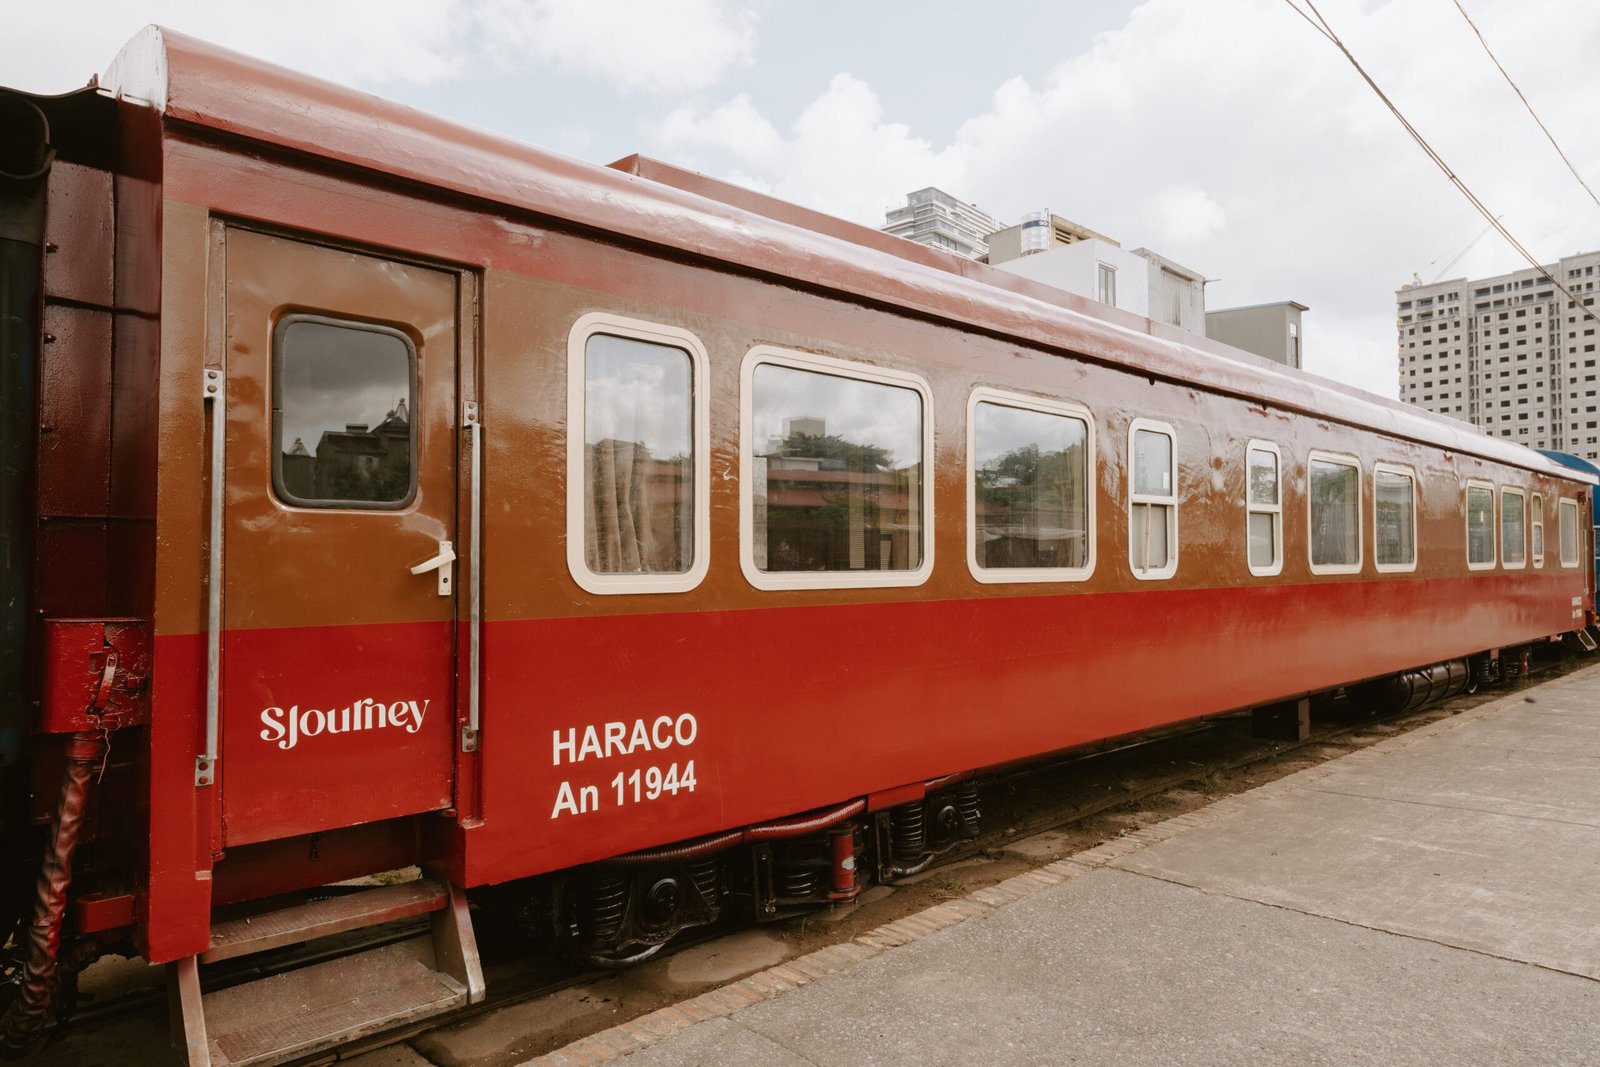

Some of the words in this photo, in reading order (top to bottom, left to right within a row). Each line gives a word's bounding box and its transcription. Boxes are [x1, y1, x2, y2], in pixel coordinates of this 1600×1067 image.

[552, 713, 698, 766] HARACO
[550, 781, 599, 819] An
[611, 760, 697, 806] 11944
